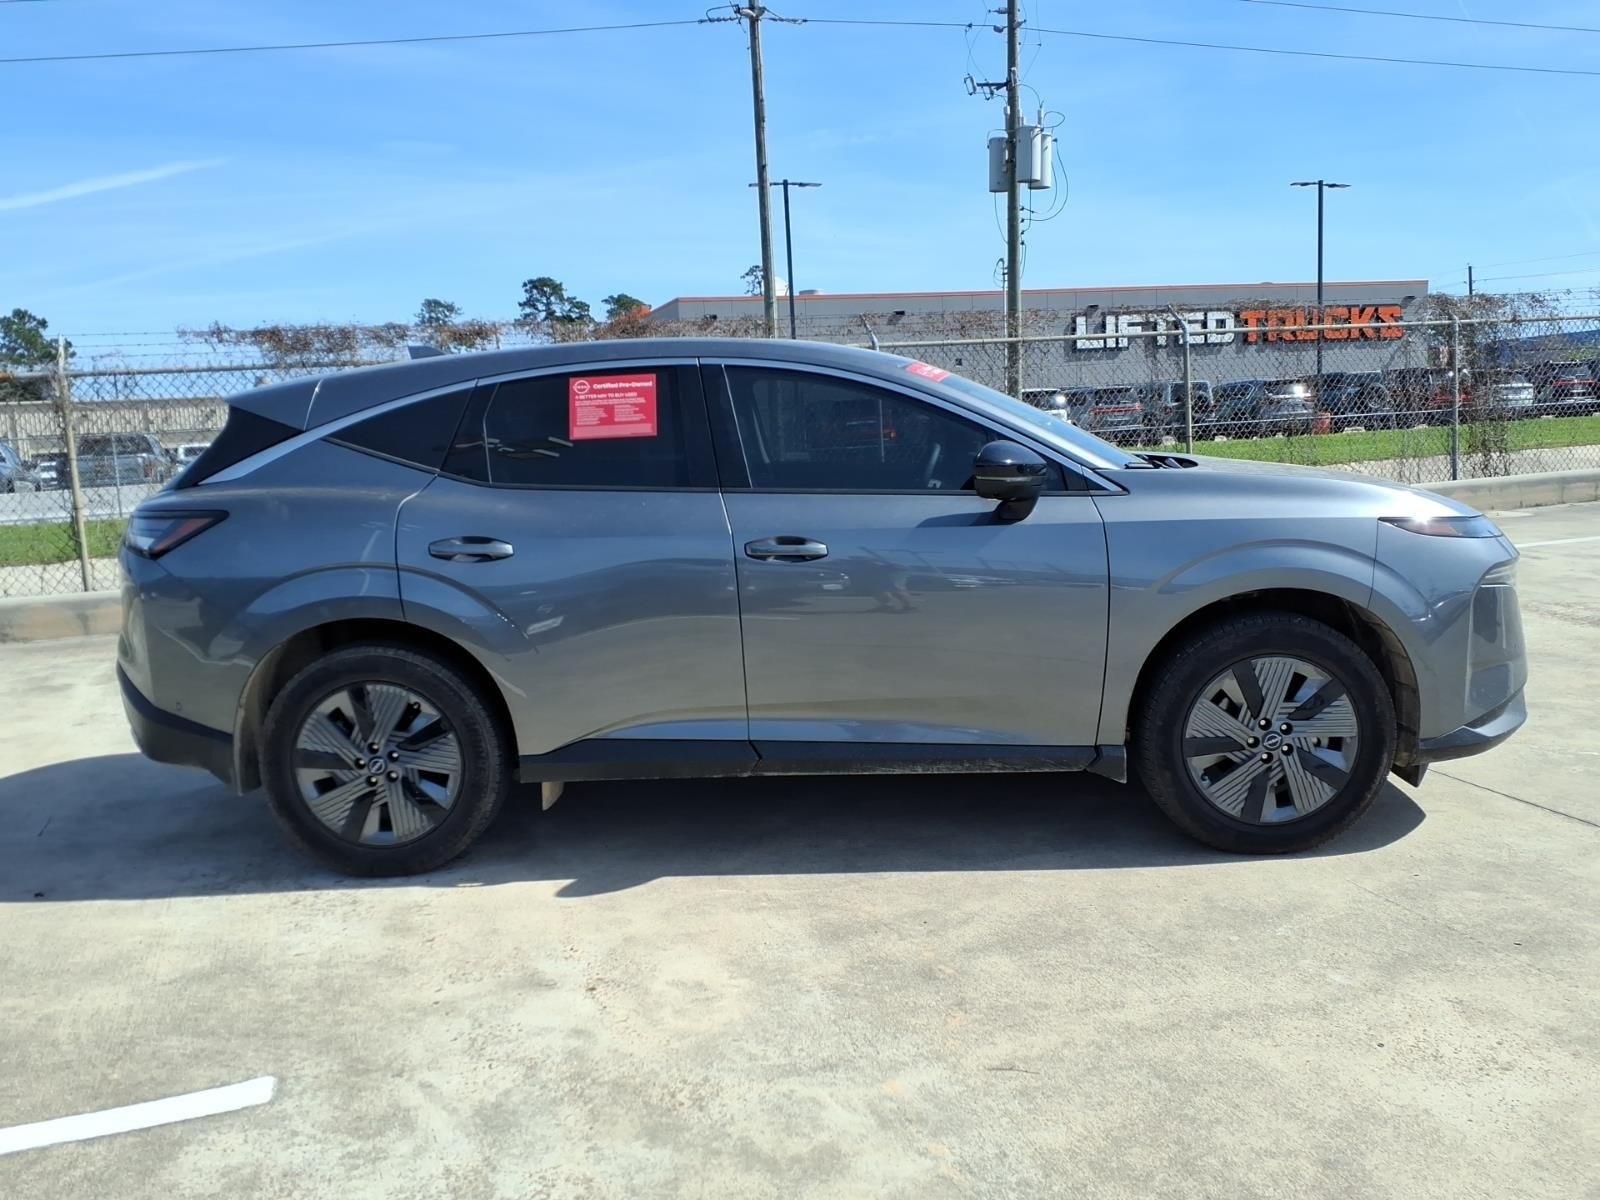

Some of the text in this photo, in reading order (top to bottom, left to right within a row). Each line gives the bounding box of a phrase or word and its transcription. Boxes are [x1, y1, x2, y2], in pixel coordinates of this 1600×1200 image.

[1075, 305, 1404, 350] LIFTED TRUCKS
[593, 382, 619, 390] Certified
